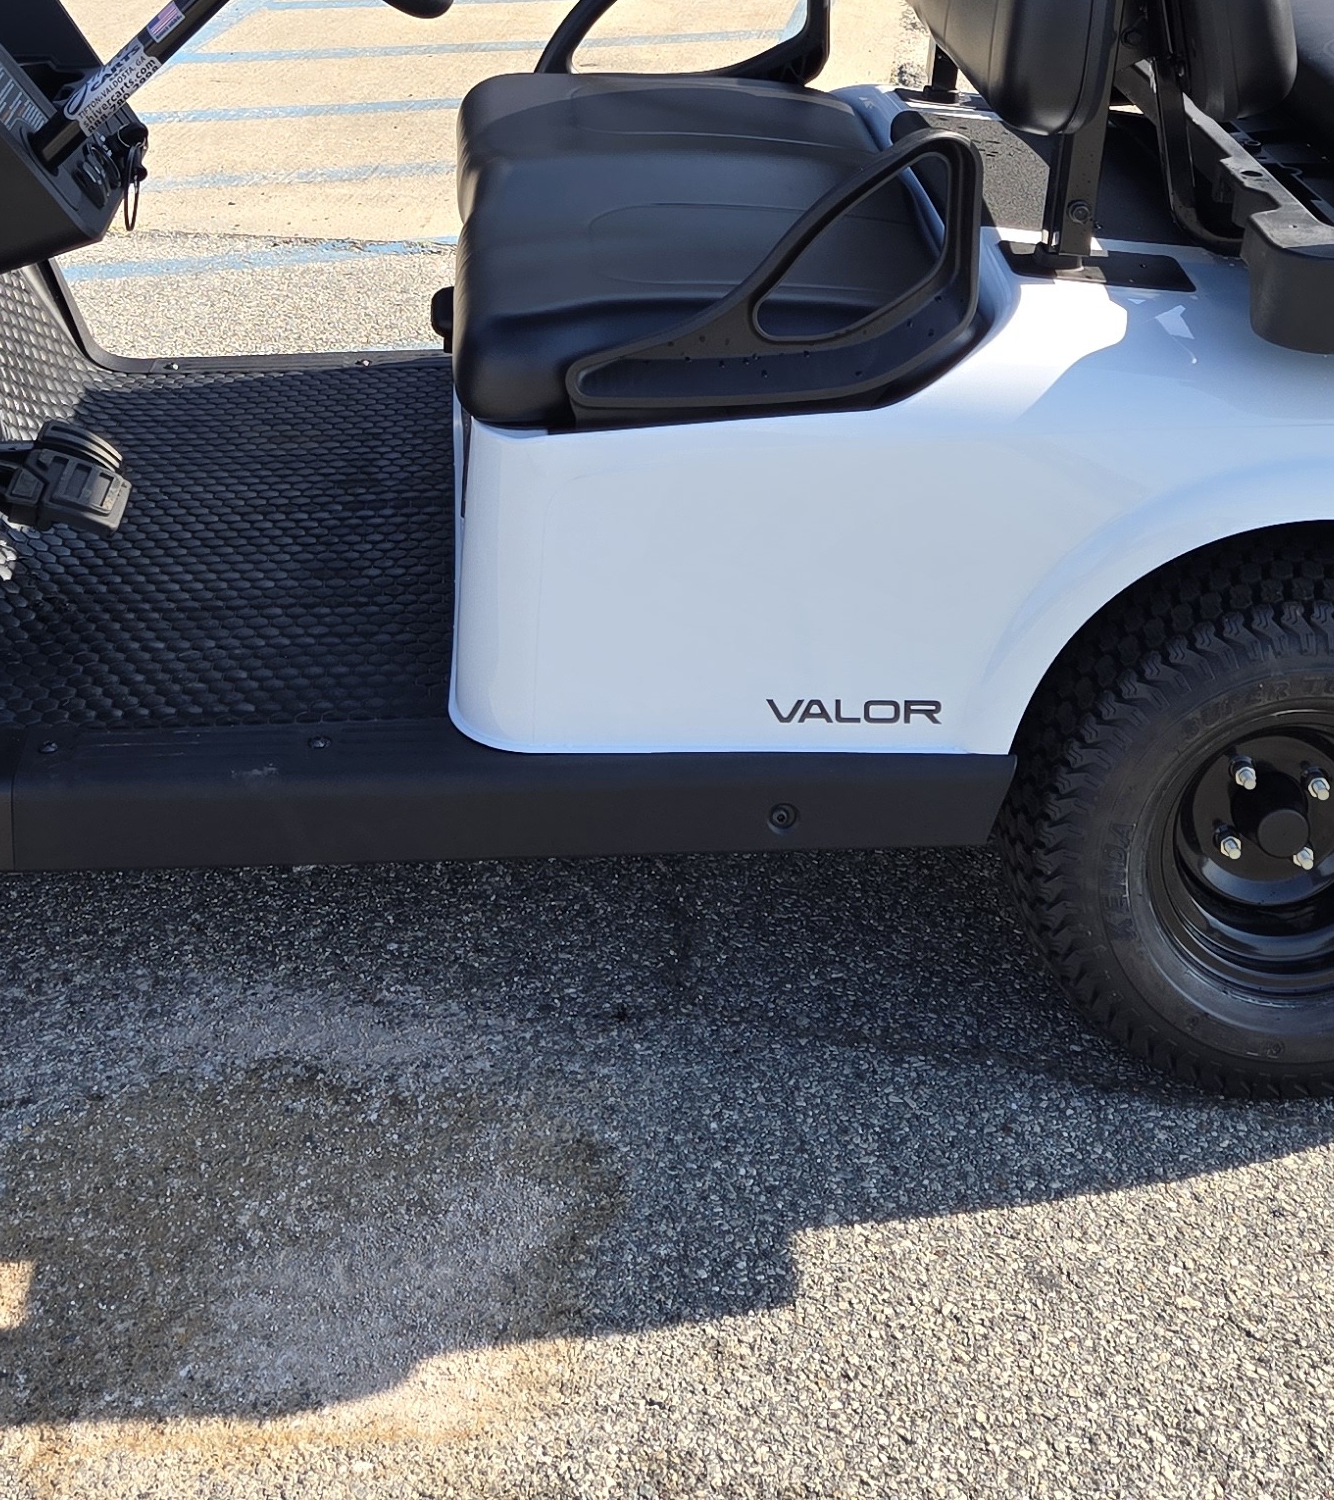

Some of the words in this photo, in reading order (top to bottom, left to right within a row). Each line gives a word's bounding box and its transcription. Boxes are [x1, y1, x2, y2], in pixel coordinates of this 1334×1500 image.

[134, 55, 146, 67] GA
[82, 57, 156, 128] shivercarts.com
[766, 699, 942, 724] VALOR
